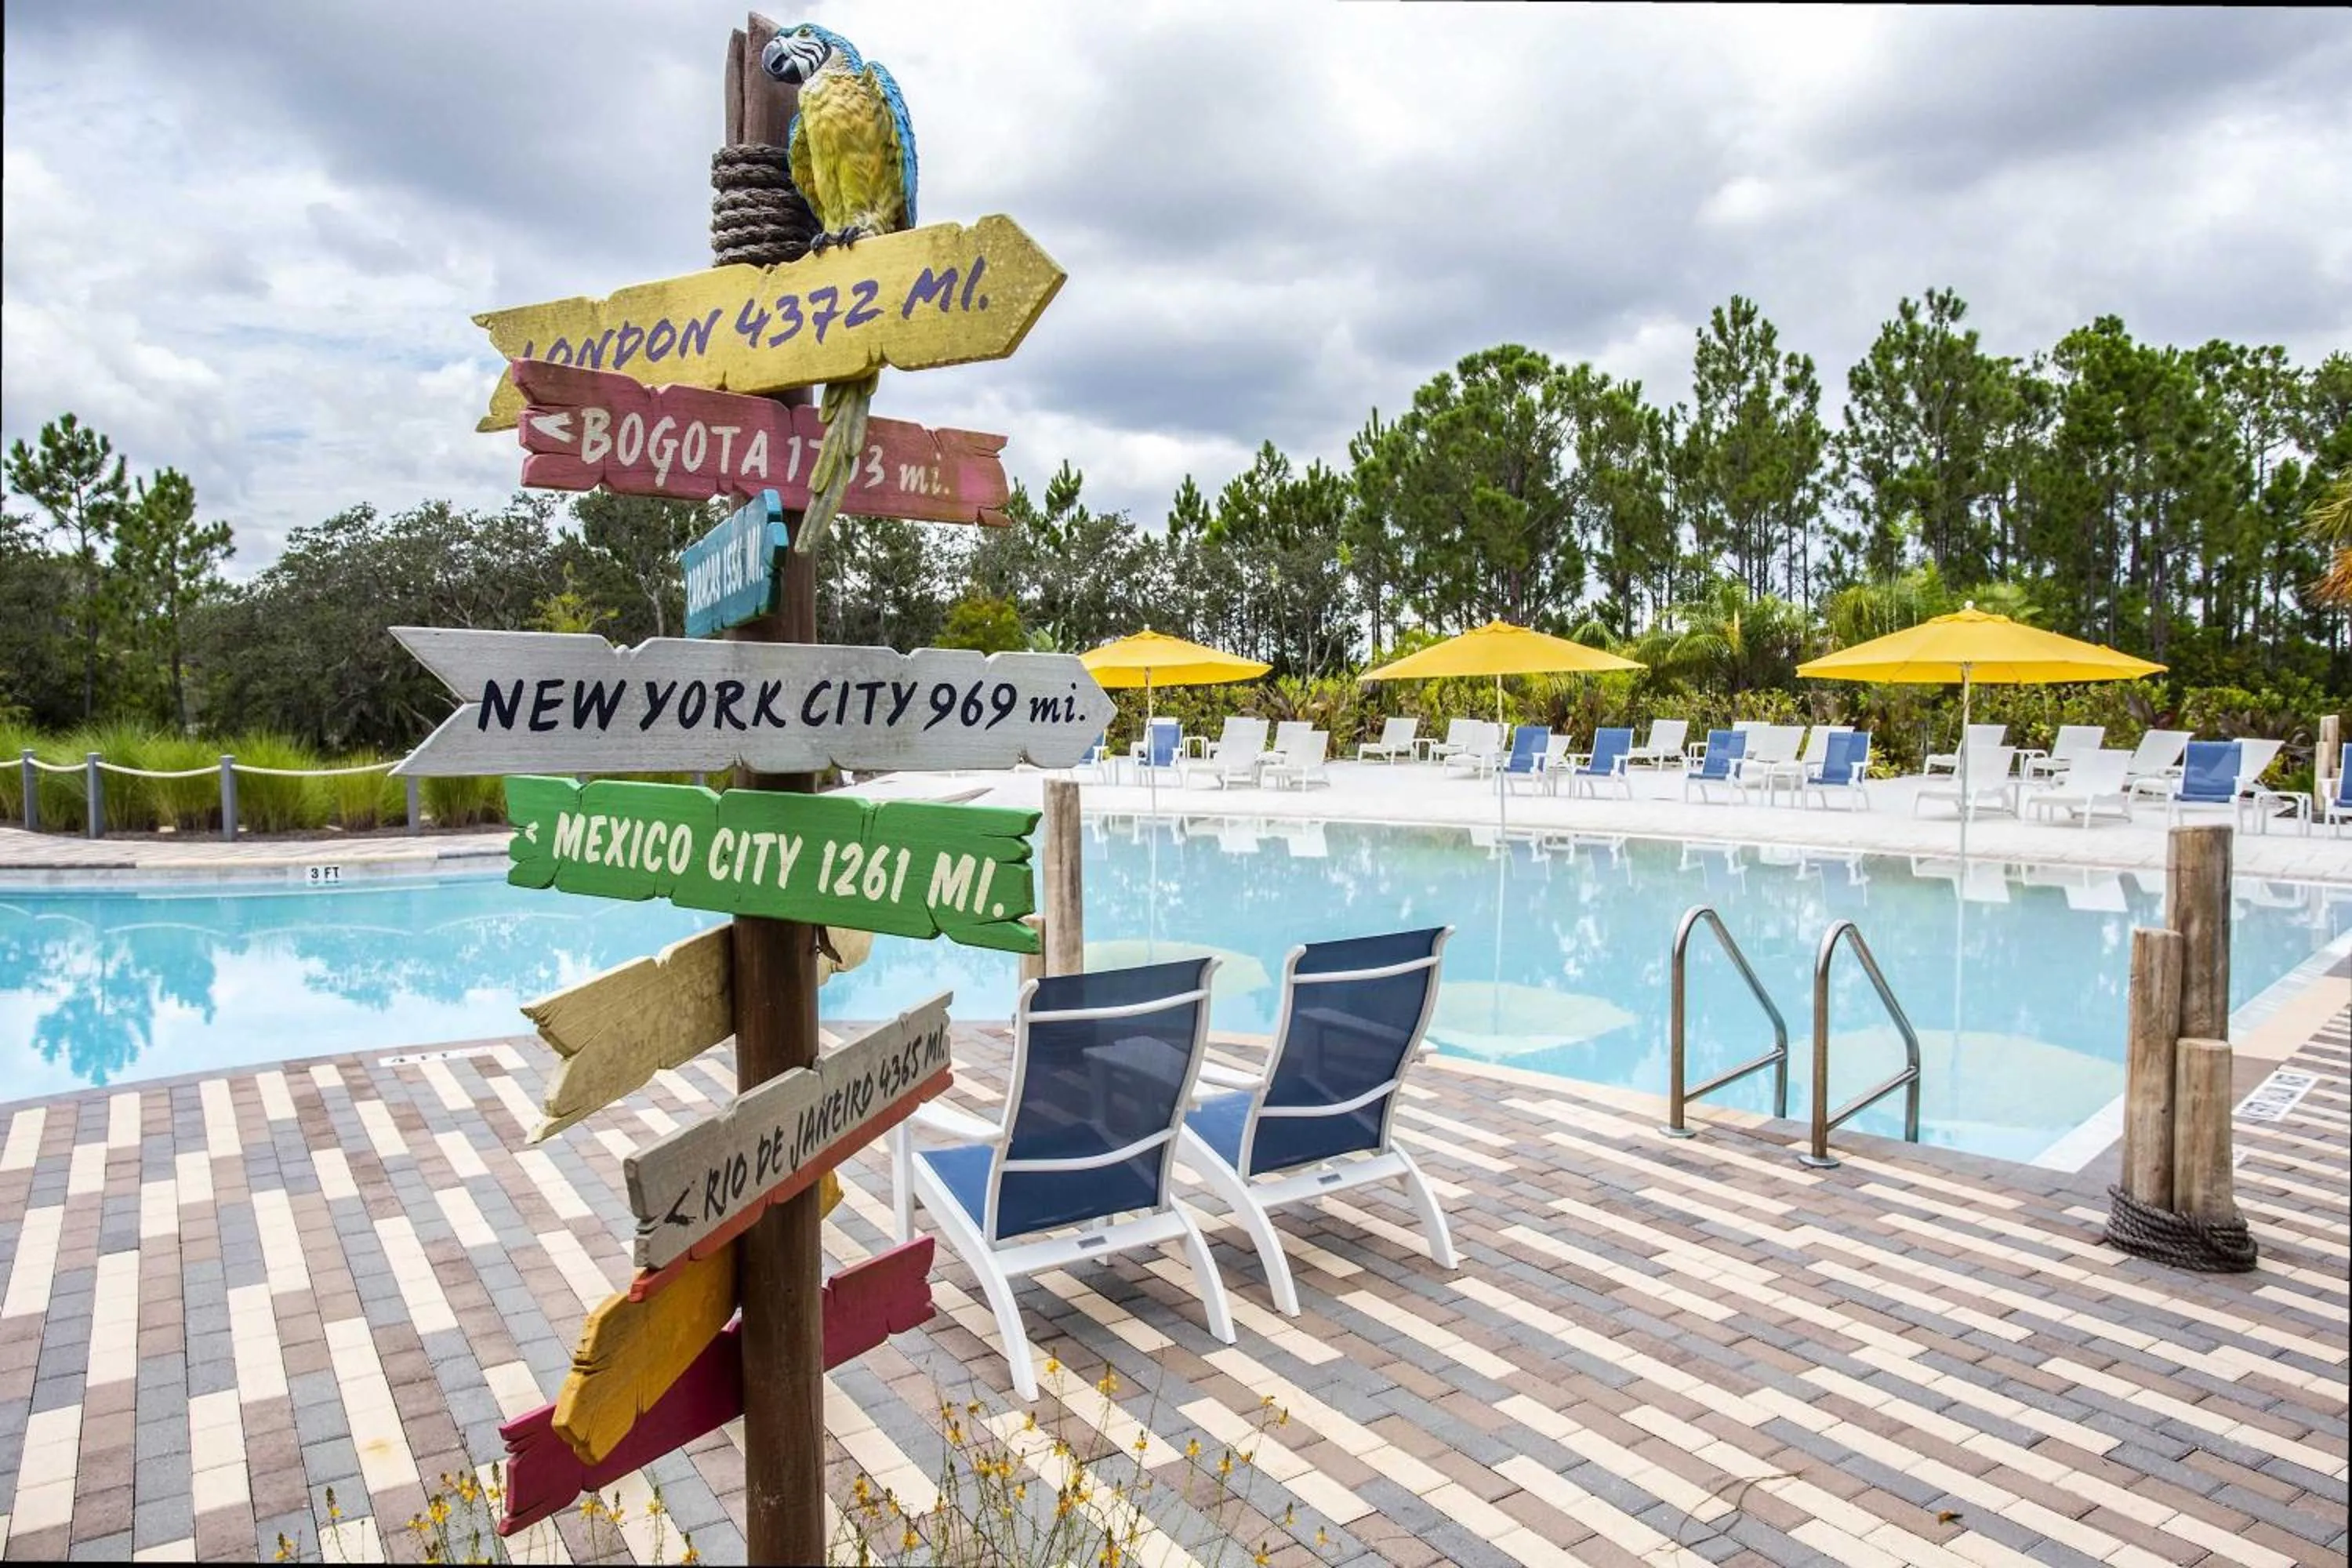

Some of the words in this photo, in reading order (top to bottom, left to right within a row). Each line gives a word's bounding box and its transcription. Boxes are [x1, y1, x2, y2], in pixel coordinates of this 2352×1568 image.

[735, 279, 884, 348] 4372
[902, 256, 989, 320] MI.
[581, 407, 768, 488] BOGOTA
[900, 452, 950, 495] mi.
[747, 524, 764, 585] MI.
[478, 679, 626, 731] NEW
[640, 680, 786, 731] YORK
[800, 680, 918, 728] CITY
[923, 680, 1018, 731] 969
[1029, 682, 1086, 723] mi.
[311, 867, 319, 879] 3
[325, 866, 339, 879] FT
[553, 811, 693, 875] MEXICO
[708, 827, 804, 889] CITY
[818, 840, 911, 903] 1261
[927, 851, 1004, 917] MI.
[705, 1152, 747, 1221] RIO
[756, 1125, 784, 1186] DE
[789, 1071, 873, 1173] JANEIRO
[879, 1035, 923, 1098] 4365
[924, 1022, 946, 1069] MI.
